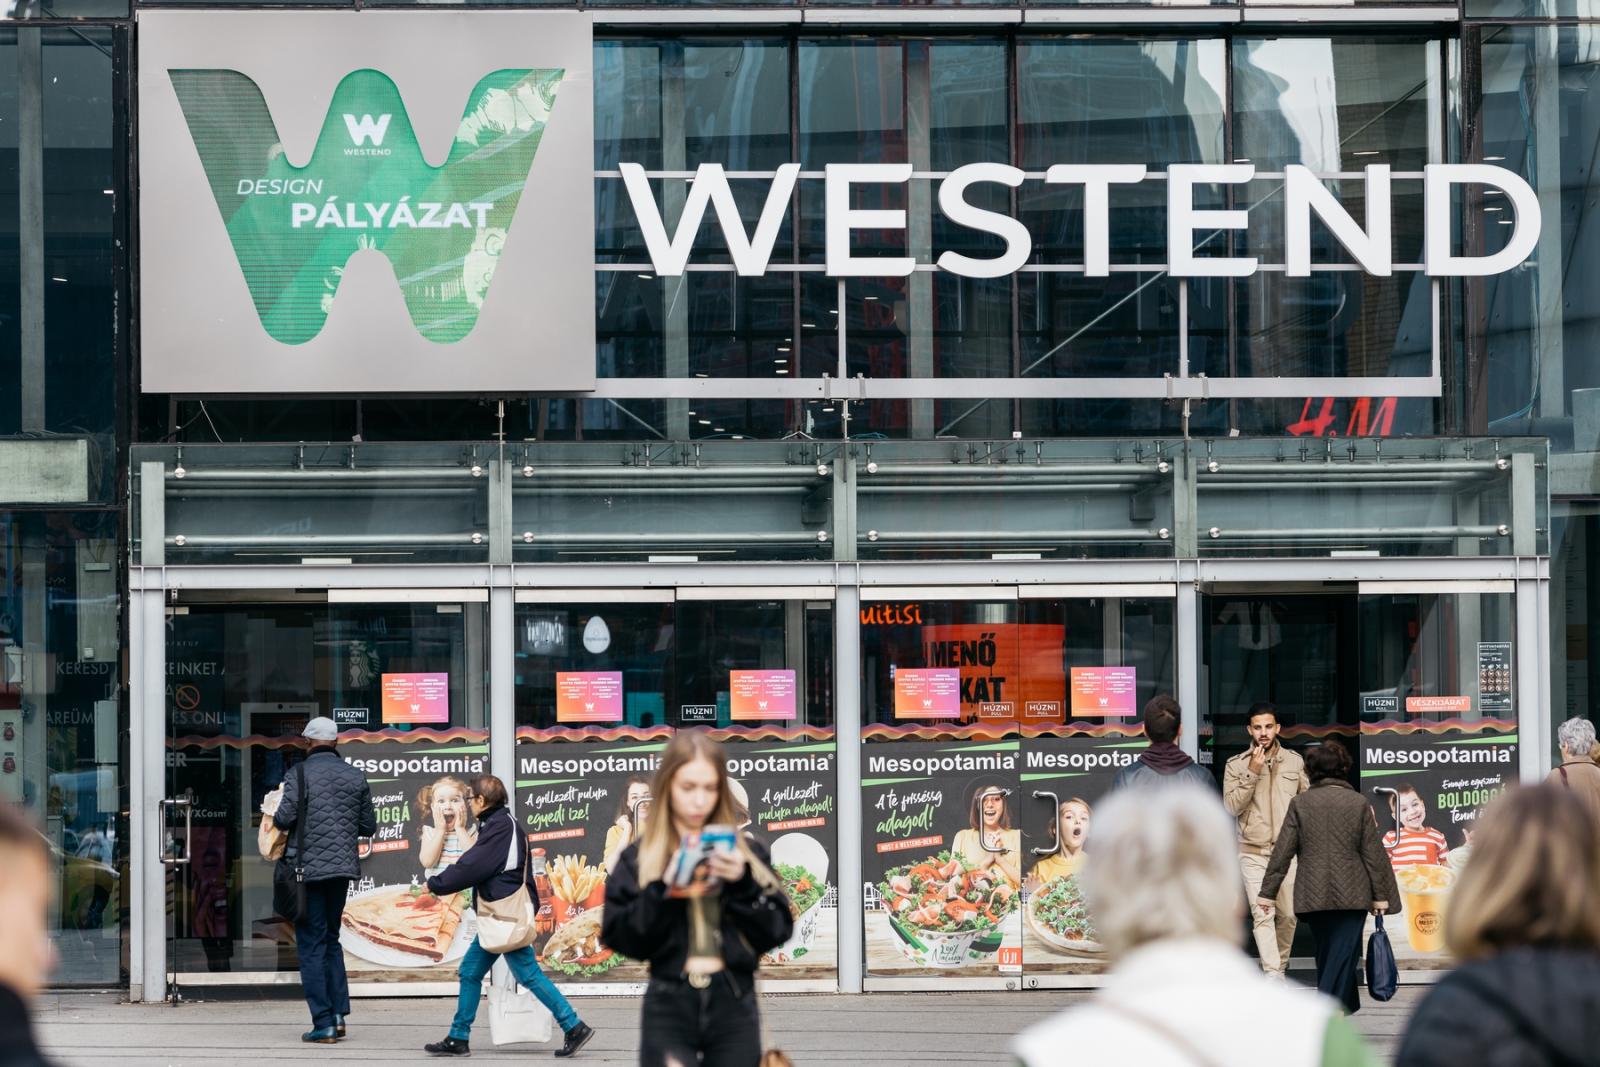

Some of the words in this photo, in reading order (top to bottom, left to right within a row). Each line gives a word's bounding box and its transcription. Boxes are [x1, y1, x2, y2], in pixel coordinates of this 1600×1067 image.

[343, 148, 392, 157] WESTEND
[236, 178, 324, 196] DESIGN
[291, 194, 495, 229] PÁLYÁZAT
[618, 162, 1542, 279] WESTEND
[930, 632, 998, 668] MENŐ
[56, 662, 109, 675] KERESD
[685, 705, 713, 715] HÚZNI
[983, 703, 1010, 712] HÚZNI
[1029, 702, 1056, 711] HÚZNI
[1368, 697, 1395, 707] HÚZNI
[337, 709, 365, 718] HÚZNI
[869, 752, 1015, 776] Mesopotamia
[1366, 745, 1511, 768] Mesopotamia
[525, 793, 534, 807] A
[761, 788, 772, 804] A
[874, 793, 885, 810] A
[886, 789, 899, 809] te
[876, 804, 935, 838] adagod!
